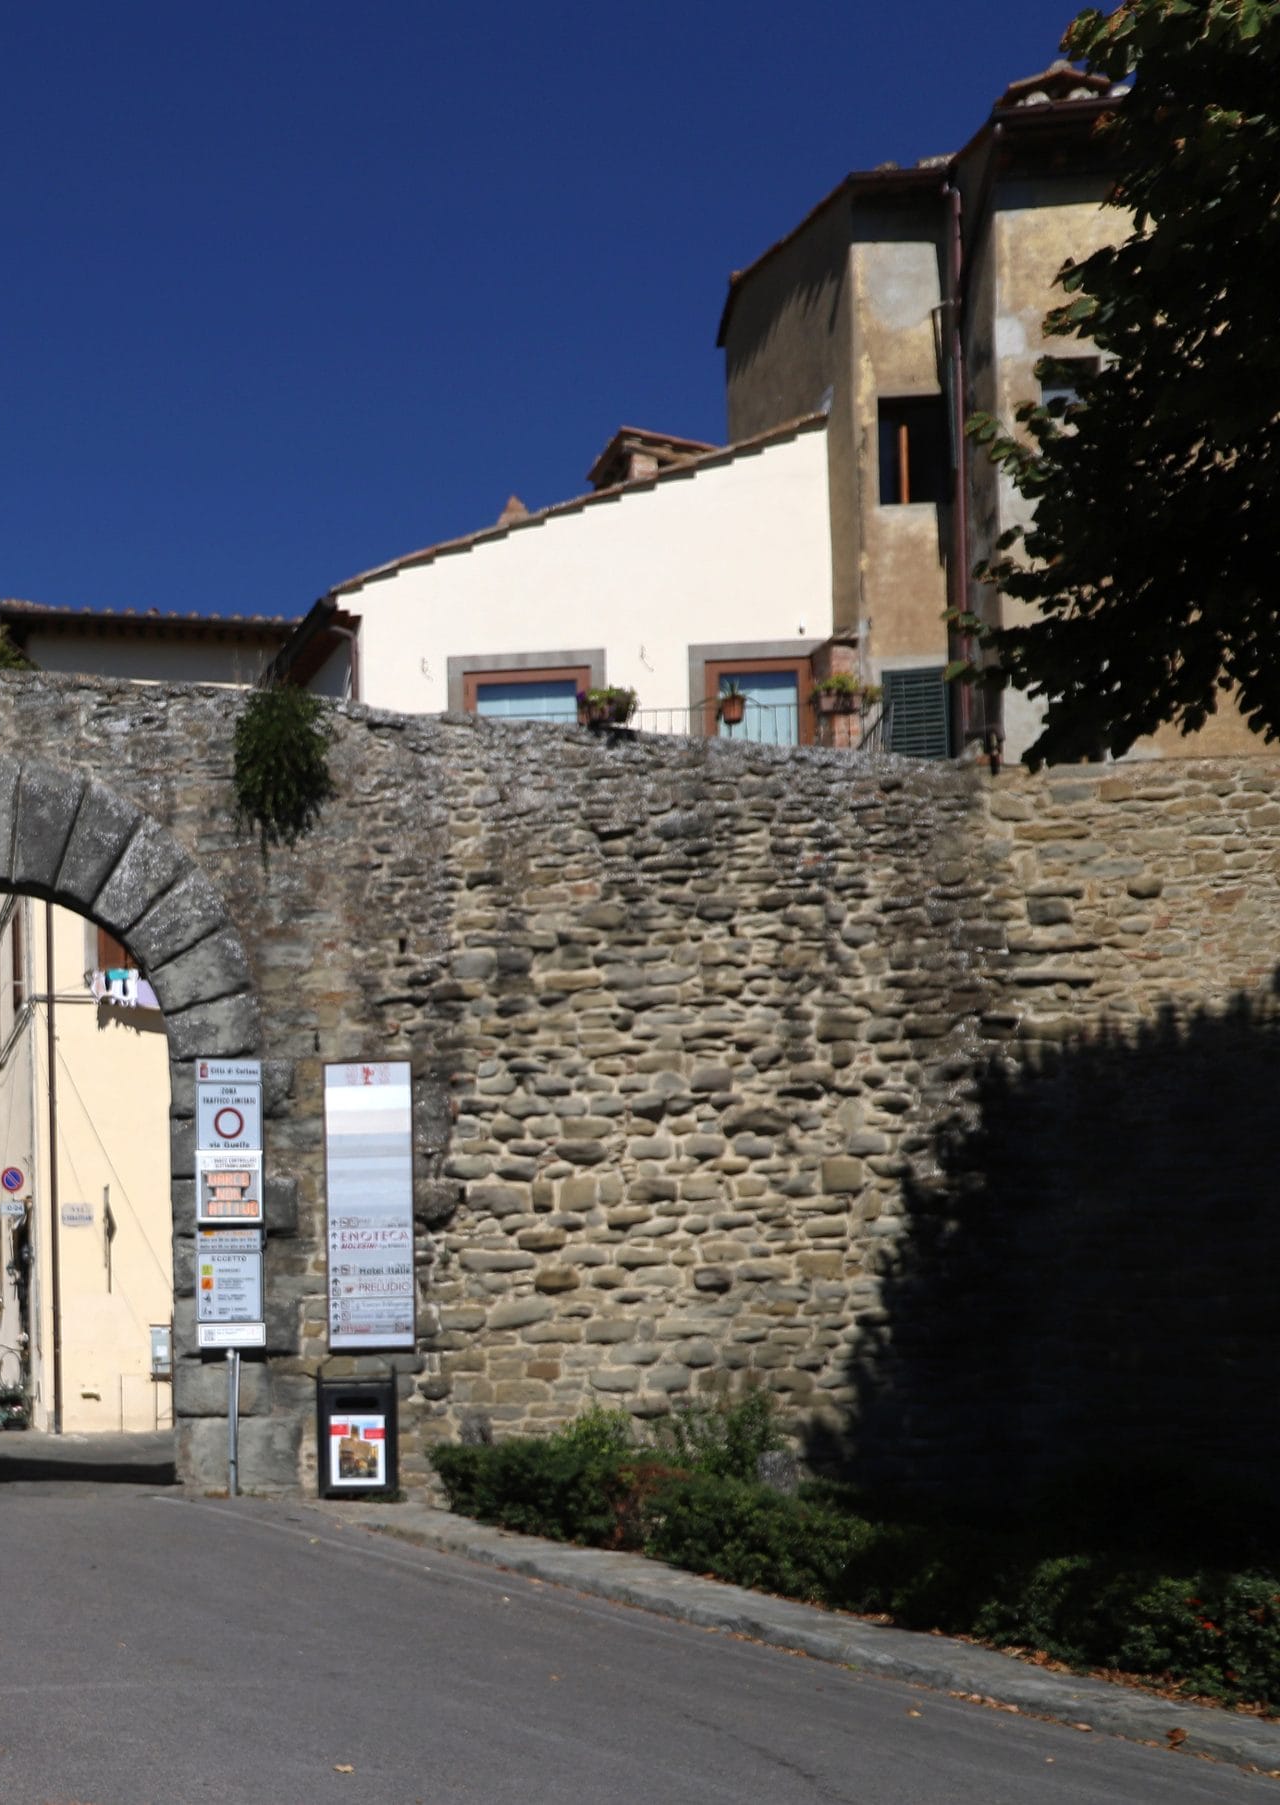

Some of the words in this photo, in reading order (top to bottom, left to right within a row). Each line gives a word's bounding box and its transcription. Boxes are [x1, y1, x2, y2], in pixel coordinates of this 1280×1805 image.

[221, 1087, 237, 1095] ZONA
[202, 1096, 231, 1105] TRAFFICO
[341, 1230, 410, 1241] ENOTECA
[211, 1255, 247, 1263] ECCETTO
[359, 1265, 385, 1276] Hotel
[358, 1281, 410, 1294] PRELUDIO
